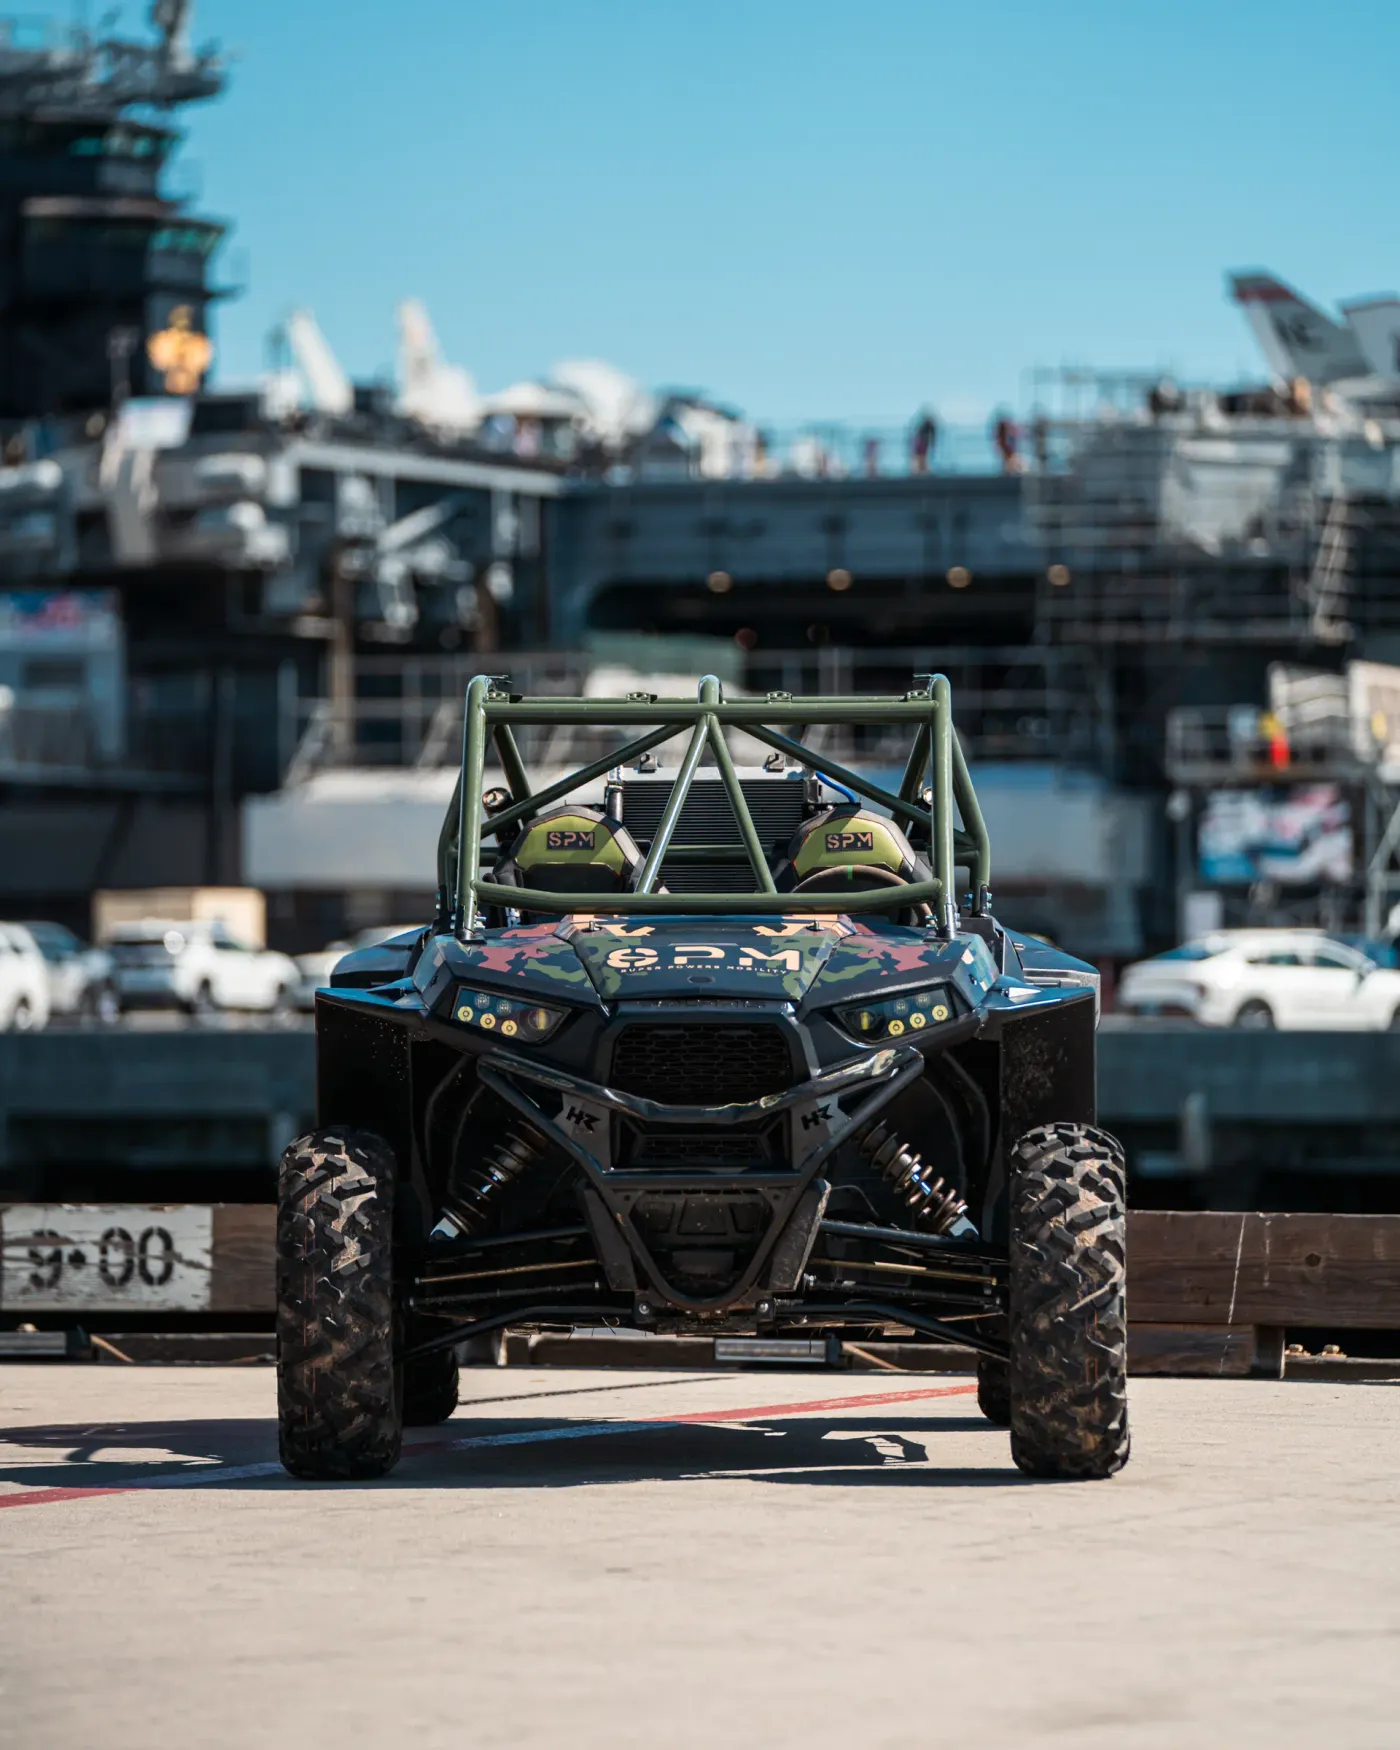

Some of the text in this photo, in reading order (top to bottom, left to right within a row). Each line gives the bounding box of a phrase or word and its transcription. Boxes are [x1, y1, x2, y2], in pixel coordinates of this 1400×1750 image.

[549, 832, 594, 847] SPM
[827, 833, 872, 849] SPM
[607, 946, 800, 971] SPM
[620, 965, 662, 973] SUPER
[726, 965, 787, 974] MOBILITY
